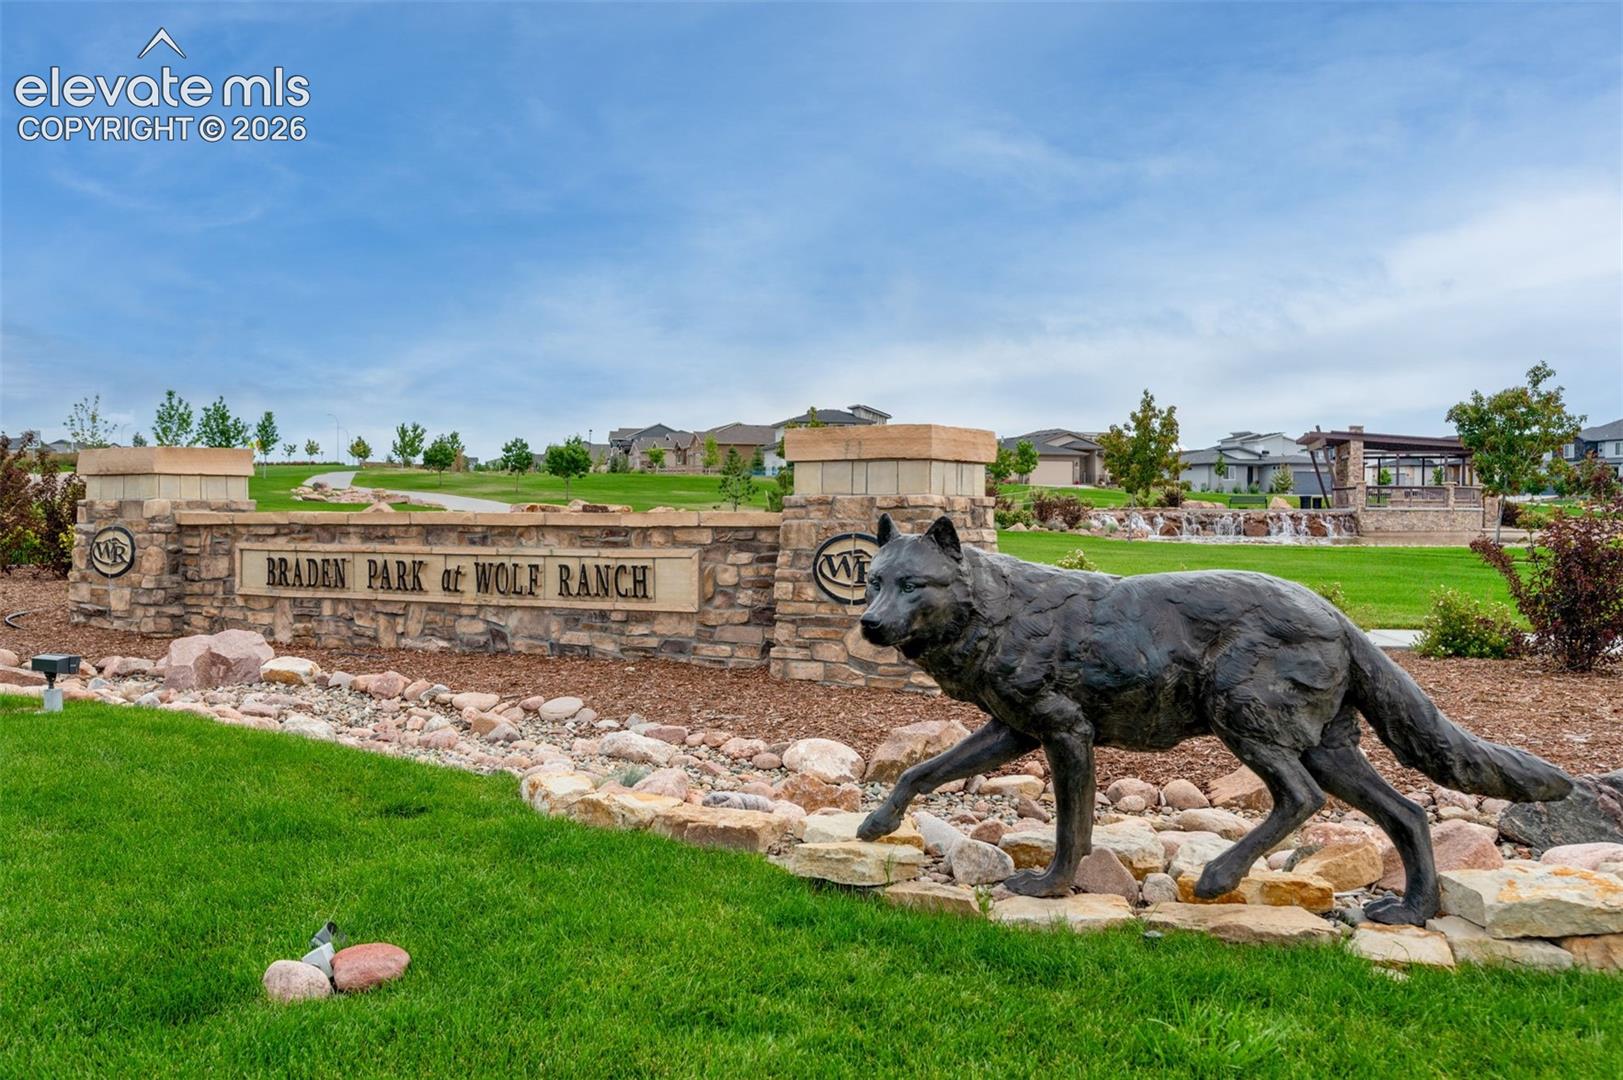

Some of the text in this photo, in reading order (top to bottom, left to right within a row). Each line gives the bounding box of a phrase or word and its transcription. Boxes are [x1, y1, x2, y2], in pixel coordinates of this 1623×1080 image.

[266, 557, 651, 599] BRADEN PARK at WOLF RANCH
